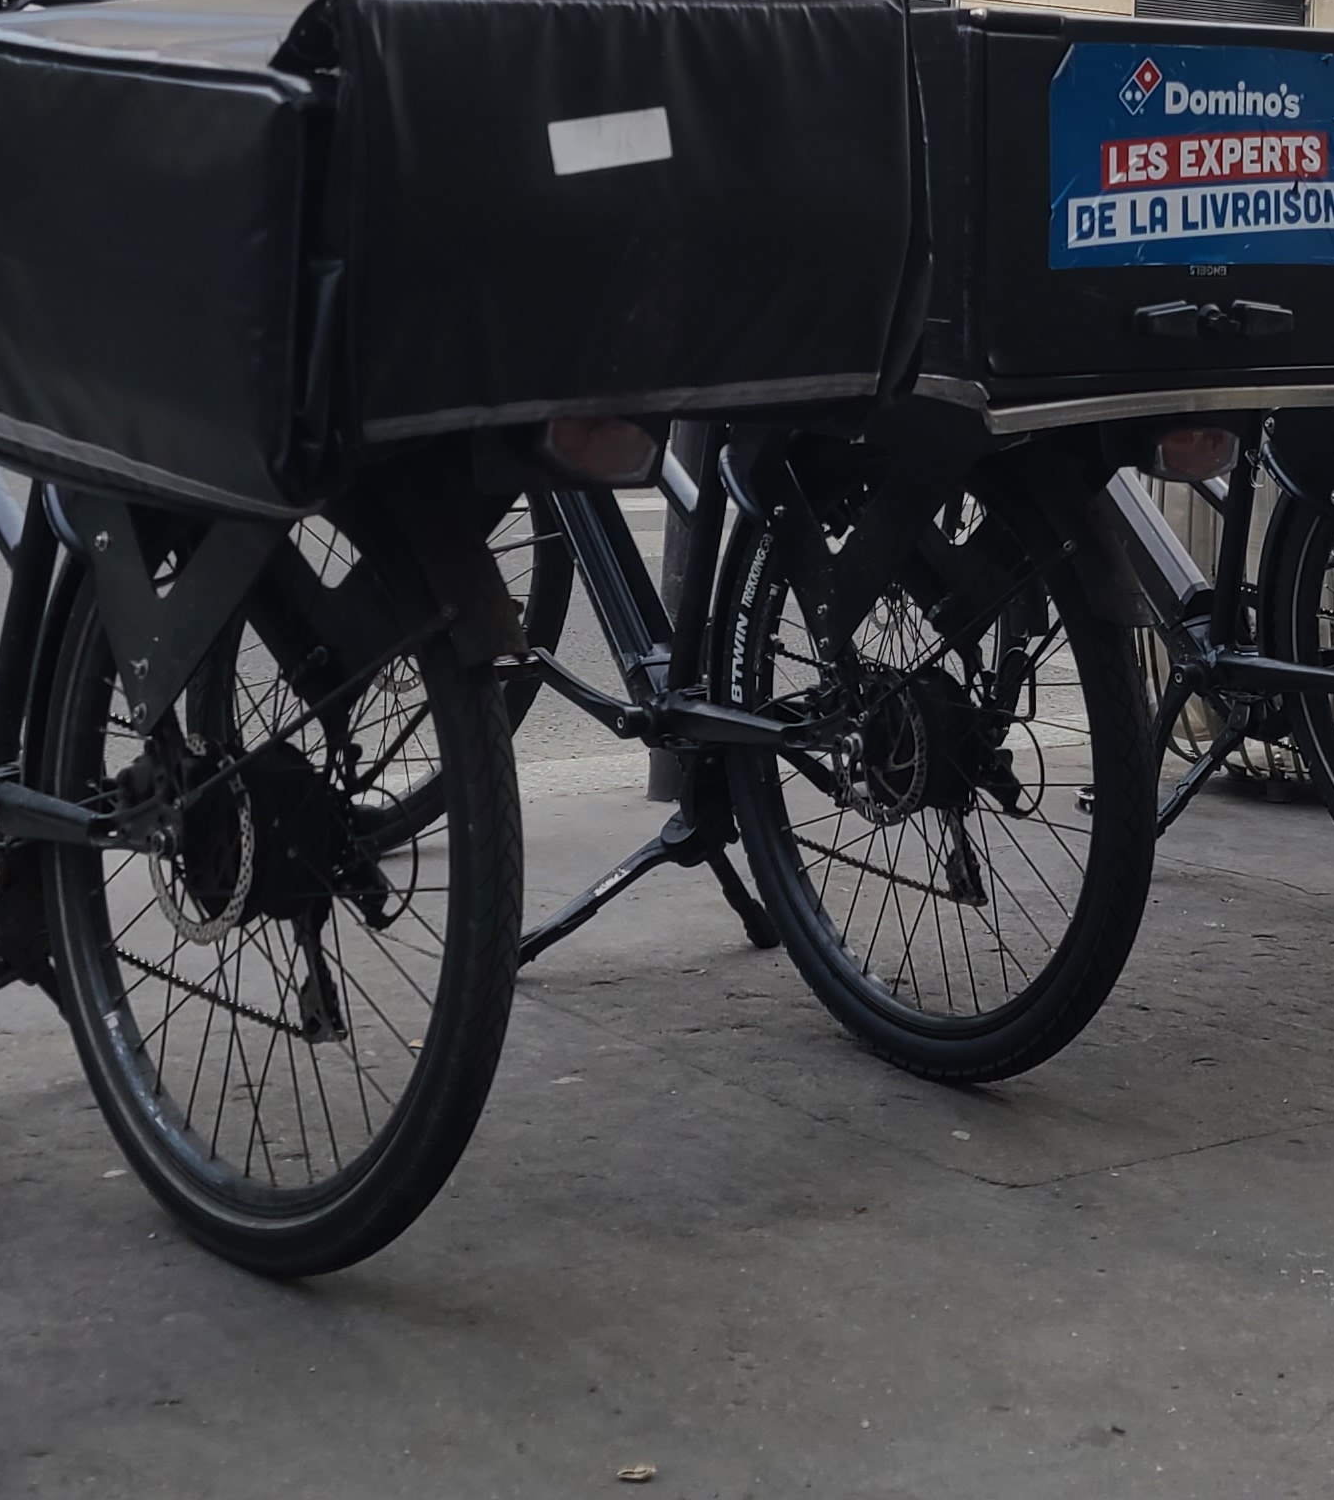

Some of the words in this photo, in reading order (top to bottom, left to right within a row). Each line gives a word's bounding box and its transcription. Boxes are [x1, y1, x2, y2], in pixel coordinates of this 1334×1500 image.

[1165, 80, 1301, 118] Domino's
[1108, 142, 1168, 185] LES
[1179, 135, 1322, 178] EXPERTS
[1075, 203, 1117, 240] DE
[1130, 197, 1168, 235] LA
[731, 612, 749, 704] BTWIN
